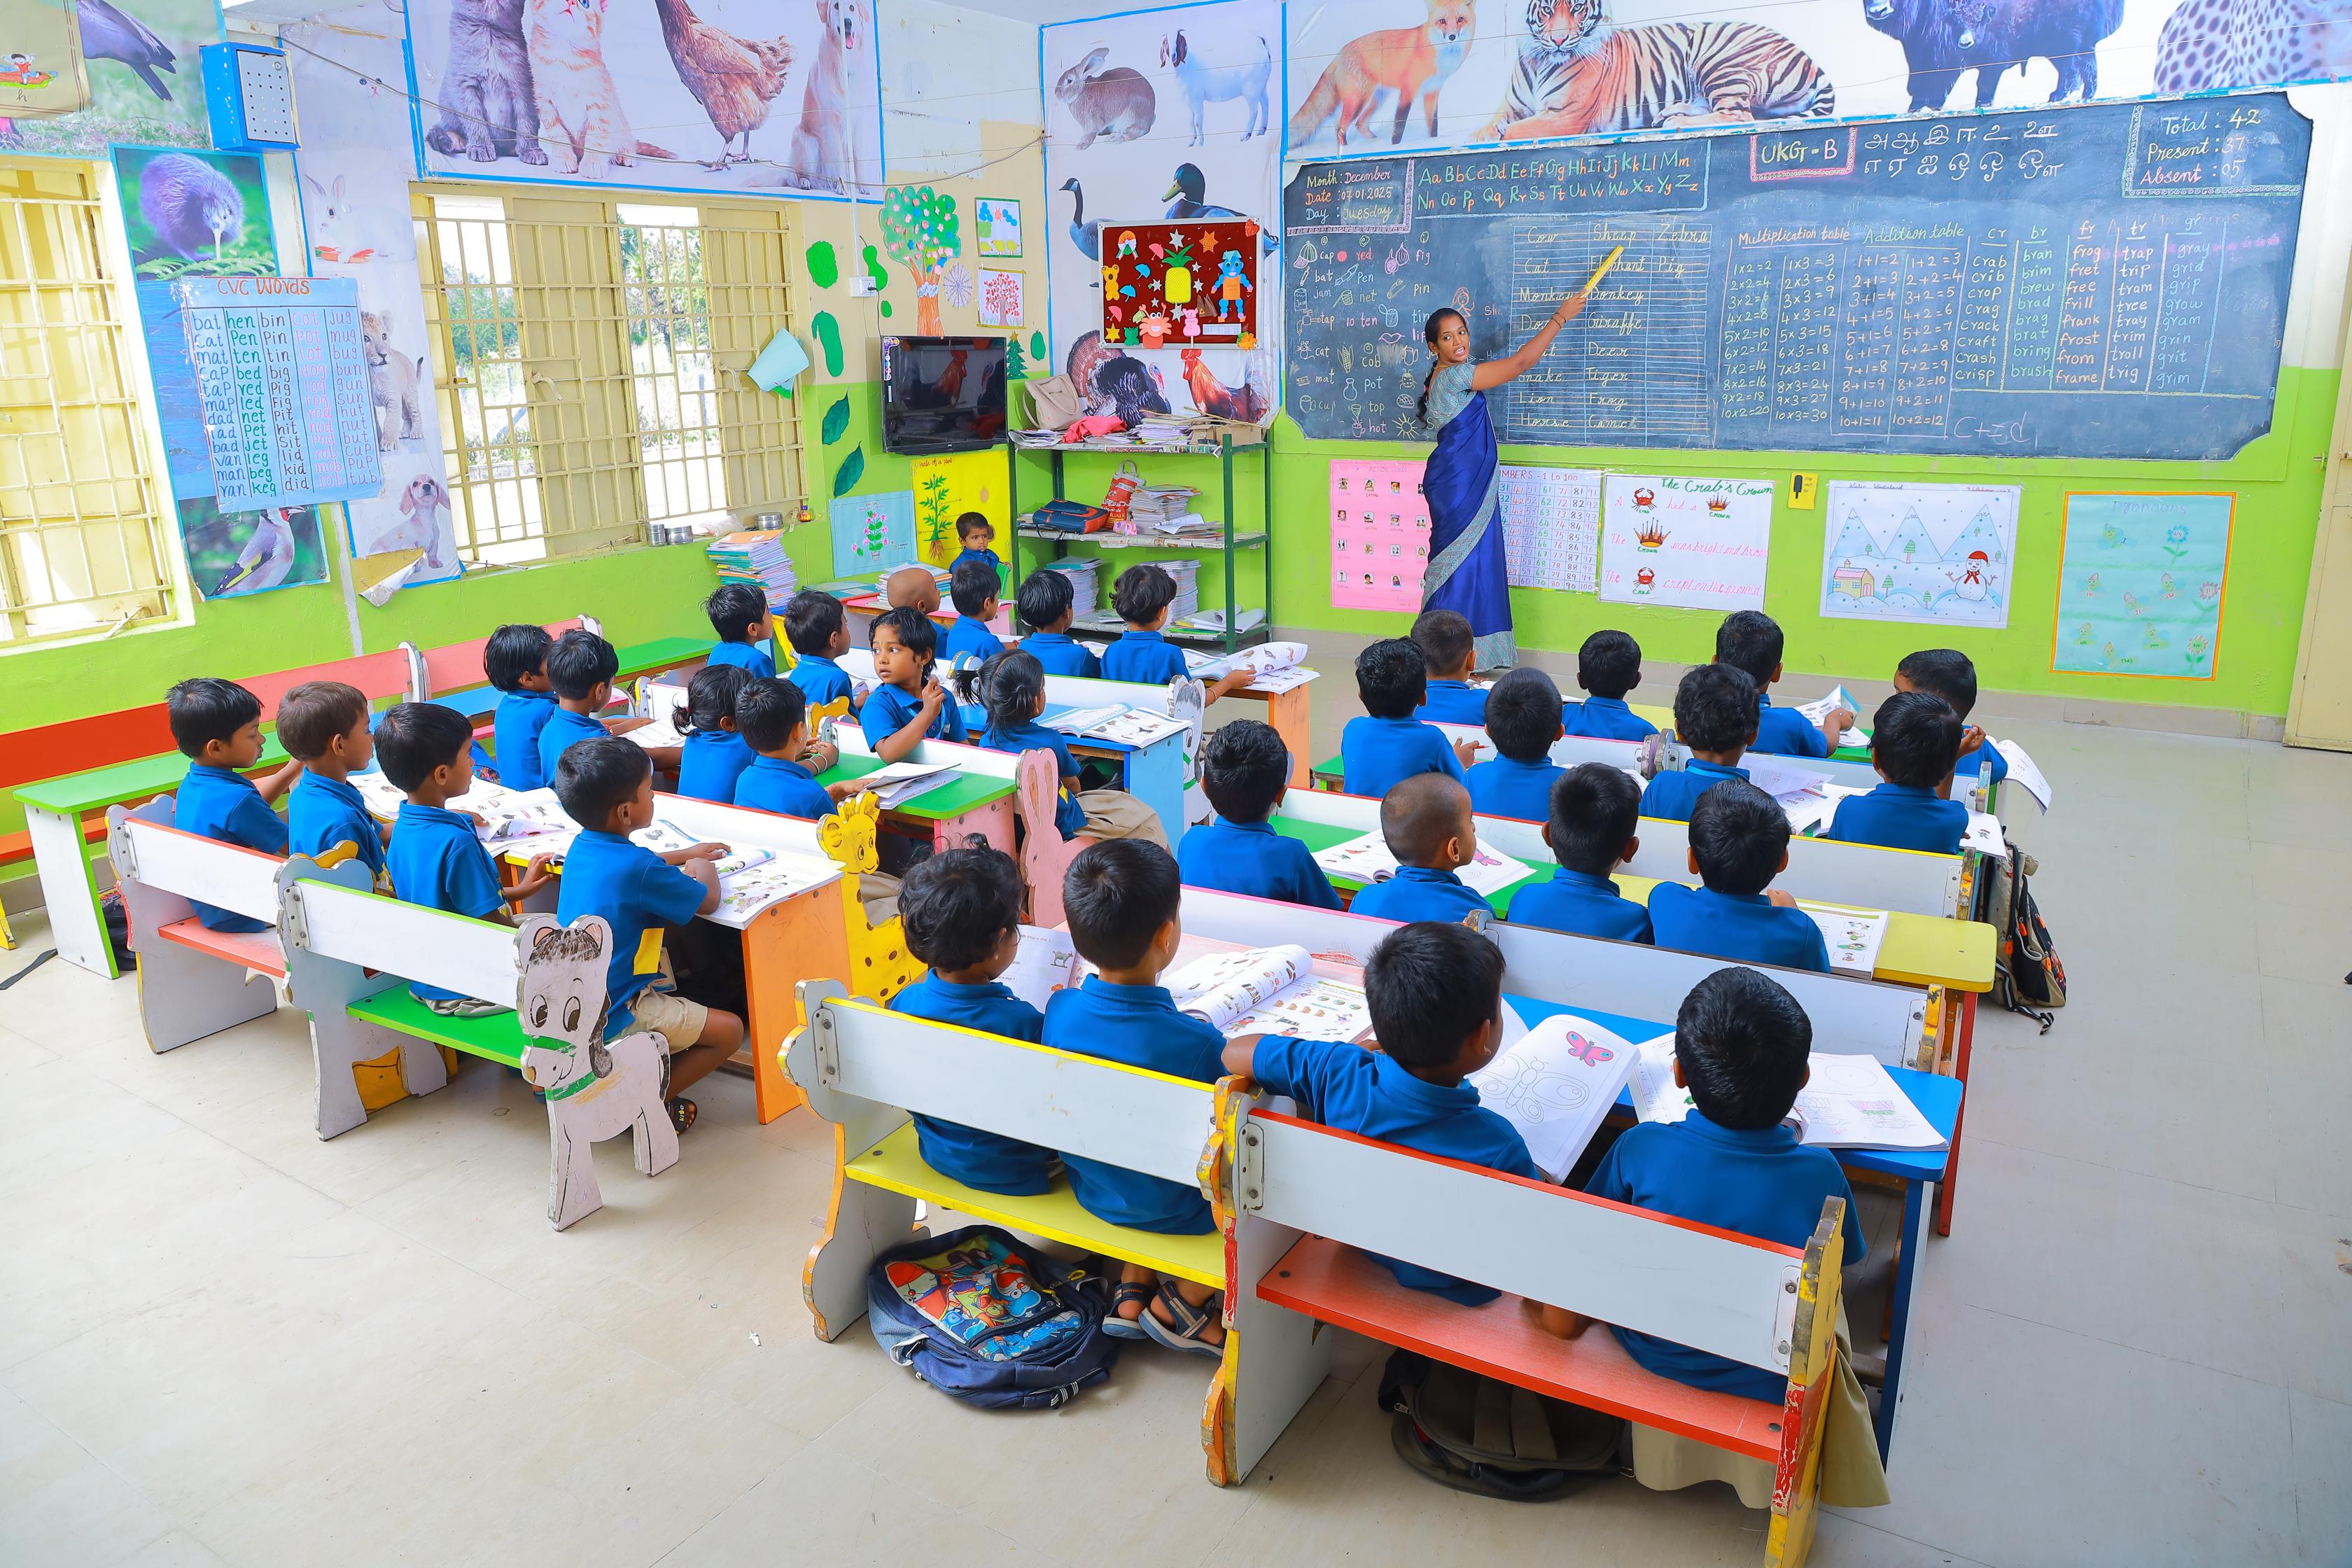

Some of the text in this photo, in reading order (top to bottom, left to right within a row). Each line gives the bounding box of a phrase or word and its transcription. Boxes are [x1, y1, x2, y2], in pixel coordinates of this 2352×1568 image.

[2162, 107, 2261, 135] Total 42
[2148, 136, 2209, 164] Present
[1345, 166, 1390, 183] December
[2140, 159, 2246, 185] Absent 05
[1593, 223, 1637, 247] Sheep
[1656, 224, 1709, 242] Zebra
[1738, 227, 1850, 246] Multiplication table
[1862, 222, 1965, 244] Addition table
[1320, 251, 1334, 264] cap
[1356, 248, 1373, 260] red
[1415, 250, 1431, 265] fig
[2023, 247, 2052, 261] bran
[2073, 244, 2101, 262] frog
[2122, 246, 2154, 264] trap
[1525, 259, 1550, 274] Cat
[1658, 256, 1685, 278] Pig
[1972, 255, 2007, 268] crab
[1315, 270, 1333, 282] bat
[1972, 269, 2005, 283] crib
[2022, 264, 2051, 277] brim
[2069, 261, 2099, 277] fret
[218, 279, 249, 295] CVC
[2118, 280, 2152, 295] tram
[227, 312, 255, 328] hen
[260, 312, 286, 326] bin
[1321, 314, 1335, 330] tap
[1361, 316, 1378, 327] ten
[1588, 312, 1642, 335] Giraffe
[2063, 312, 2100, 327] frank
[330, 330, 357, 344] mug
[1957, 335, 1997, 348] craft
[2059, 330, 2099, 346] frost
[233, 349, 261, 363] ten
[267, 349, 290, 362] tin
[1315, 346, 1330, 357] cat
[1588, 342, 1629, 357] Deer
[197, 350, 228, 364] mat
[2057, 350, 2094, 365] from
[236, 366, 262, 380] bed
[270, 366, 289, 382] big
[336, 364, 363, 377] bun
[1315, 370, 1335, 384] mat
[1586, 367, 1628, 386] Tiger
[2011, 363, 2052, 377] brush
[1364, 377, 1383, 392] pot
[2055, 370, 2097, 385] frame
[1519, 392, 1555, 404] Lion
[1589, 393, 1628, 411] Frog
[1368, 400, 1385, 416] top
[241, 411, 266, 424] net
[1520, 413, 1570, 426] Horse
[1368, 420, 1387, 433] hot
[245, 438, 267, 451] jet
[248, 452, 269, 467] leg
[217, 469, 246, 480] man
[284, 463, 306, 475] kid
[285, 477, 309, 491] did
[349, 473, 377, 485] tub
[1661, 479, 1773, 494] The Crab's Crown
[1541, 497, 1551, 505] 62
[1571, 511, 1582, 519] 83
[1570, 522, 1581, 531] 84
